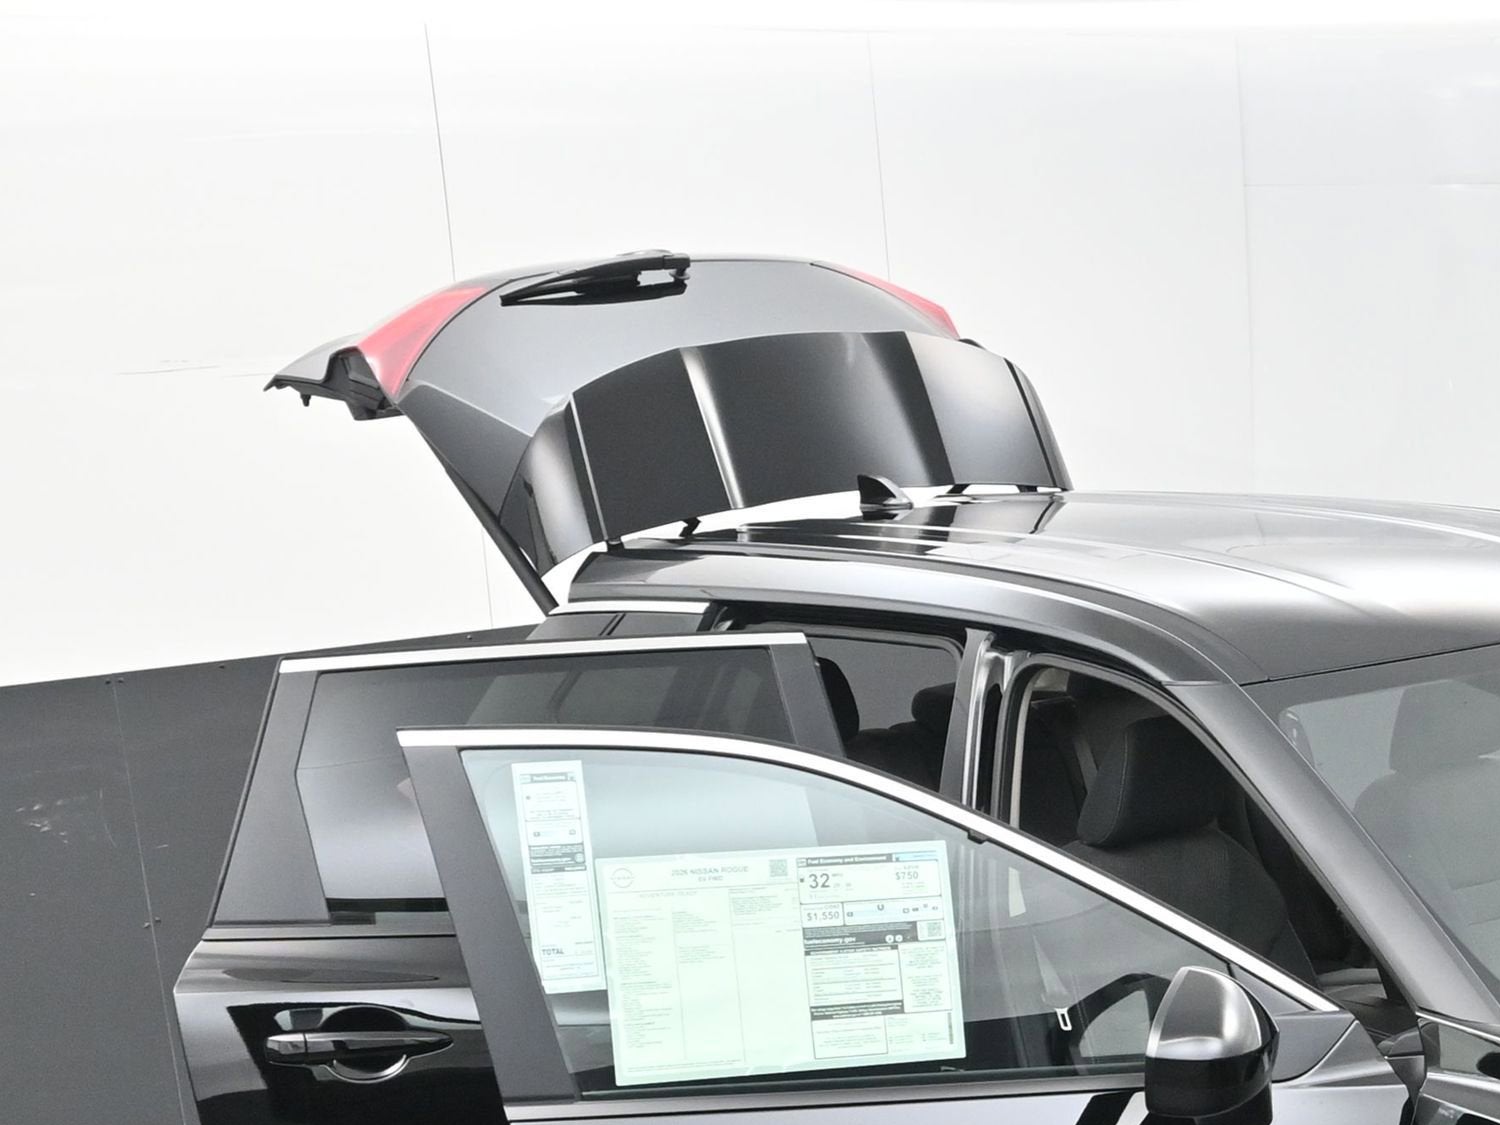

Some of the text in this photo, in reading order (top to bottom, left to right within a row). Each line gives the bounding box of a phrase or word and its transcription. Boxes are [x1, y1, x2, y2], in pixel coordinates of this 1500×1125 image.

[808, 873, 831, 889] 32
[895, 871, 919, 881] $750
[806, 910, 840, 922] $1,550
[541, 947, 565, 956] TOTAL
